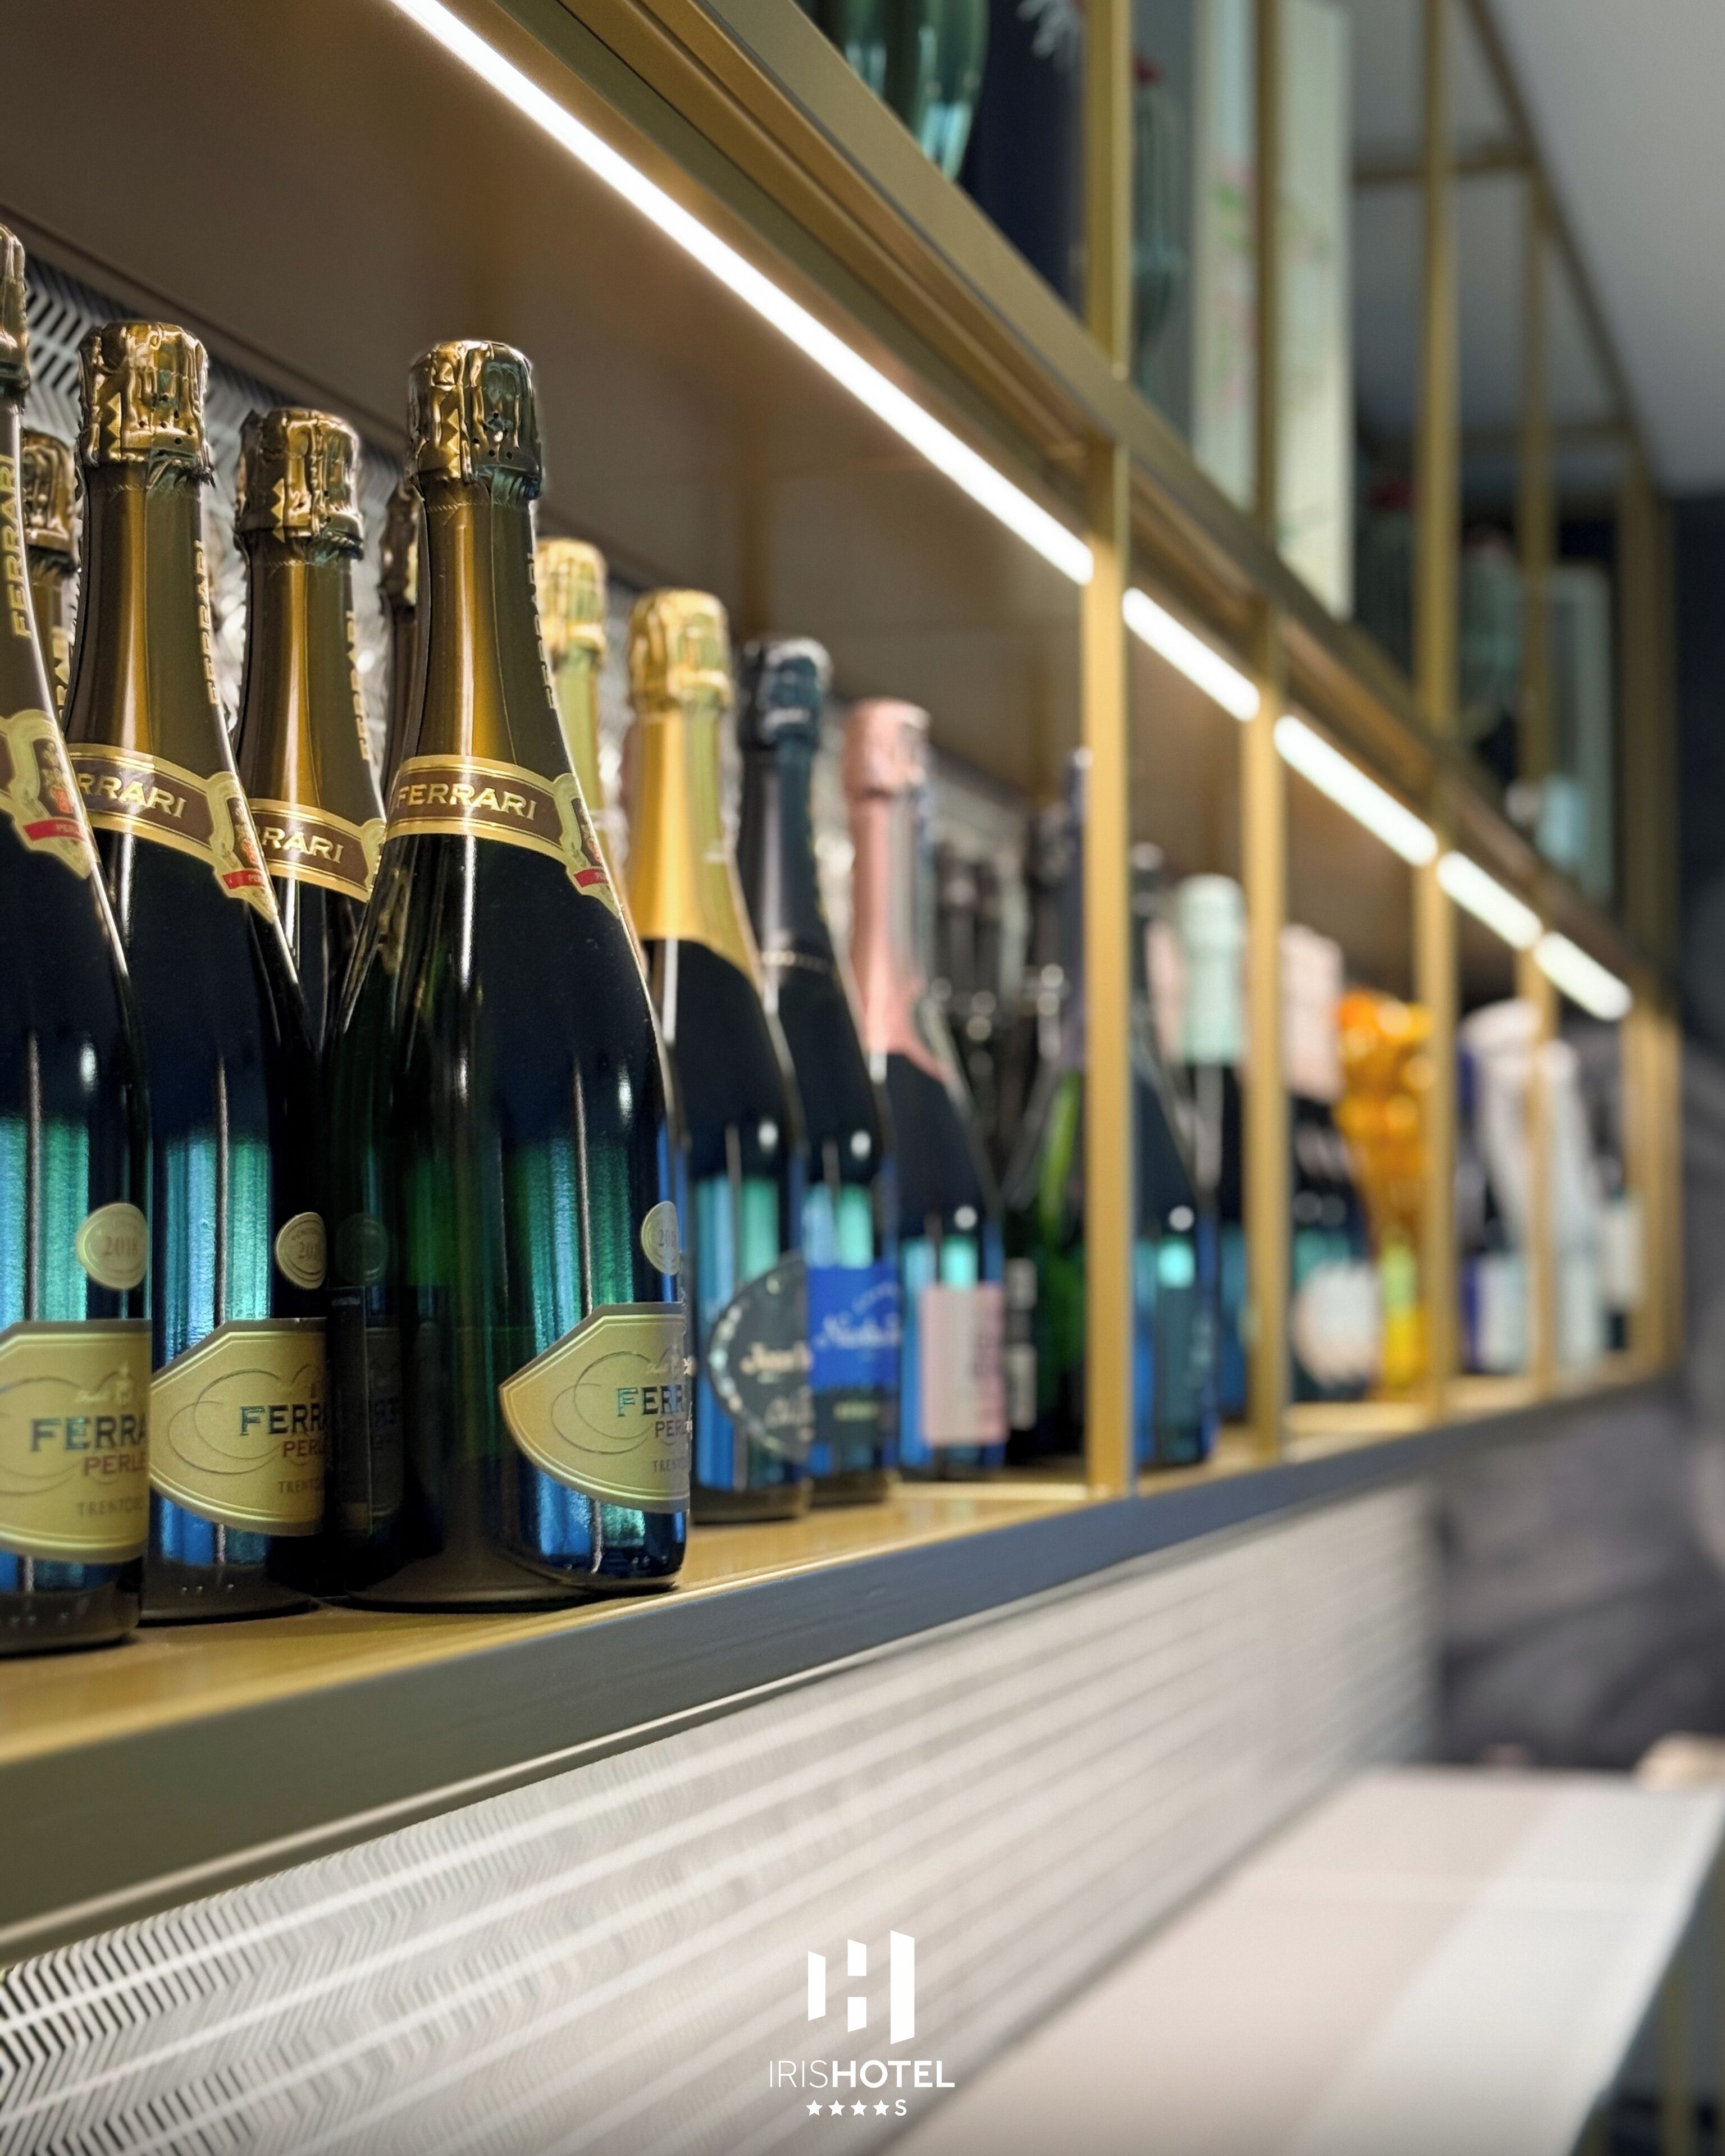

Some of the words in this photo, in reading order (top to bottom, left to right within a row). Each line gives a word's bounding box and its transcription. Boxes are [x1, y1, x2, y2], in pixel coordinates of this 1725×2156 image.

[77, 773, 187, 818] RRARI
[396, 783, 536, 820] FERRARI
[258, 826, 344, 864] RARI
[617, 1384, 686, 1417] FERR
[30, 1413, 147, 1452] FERRA
[240, 1403, 327, 1436] FERR
